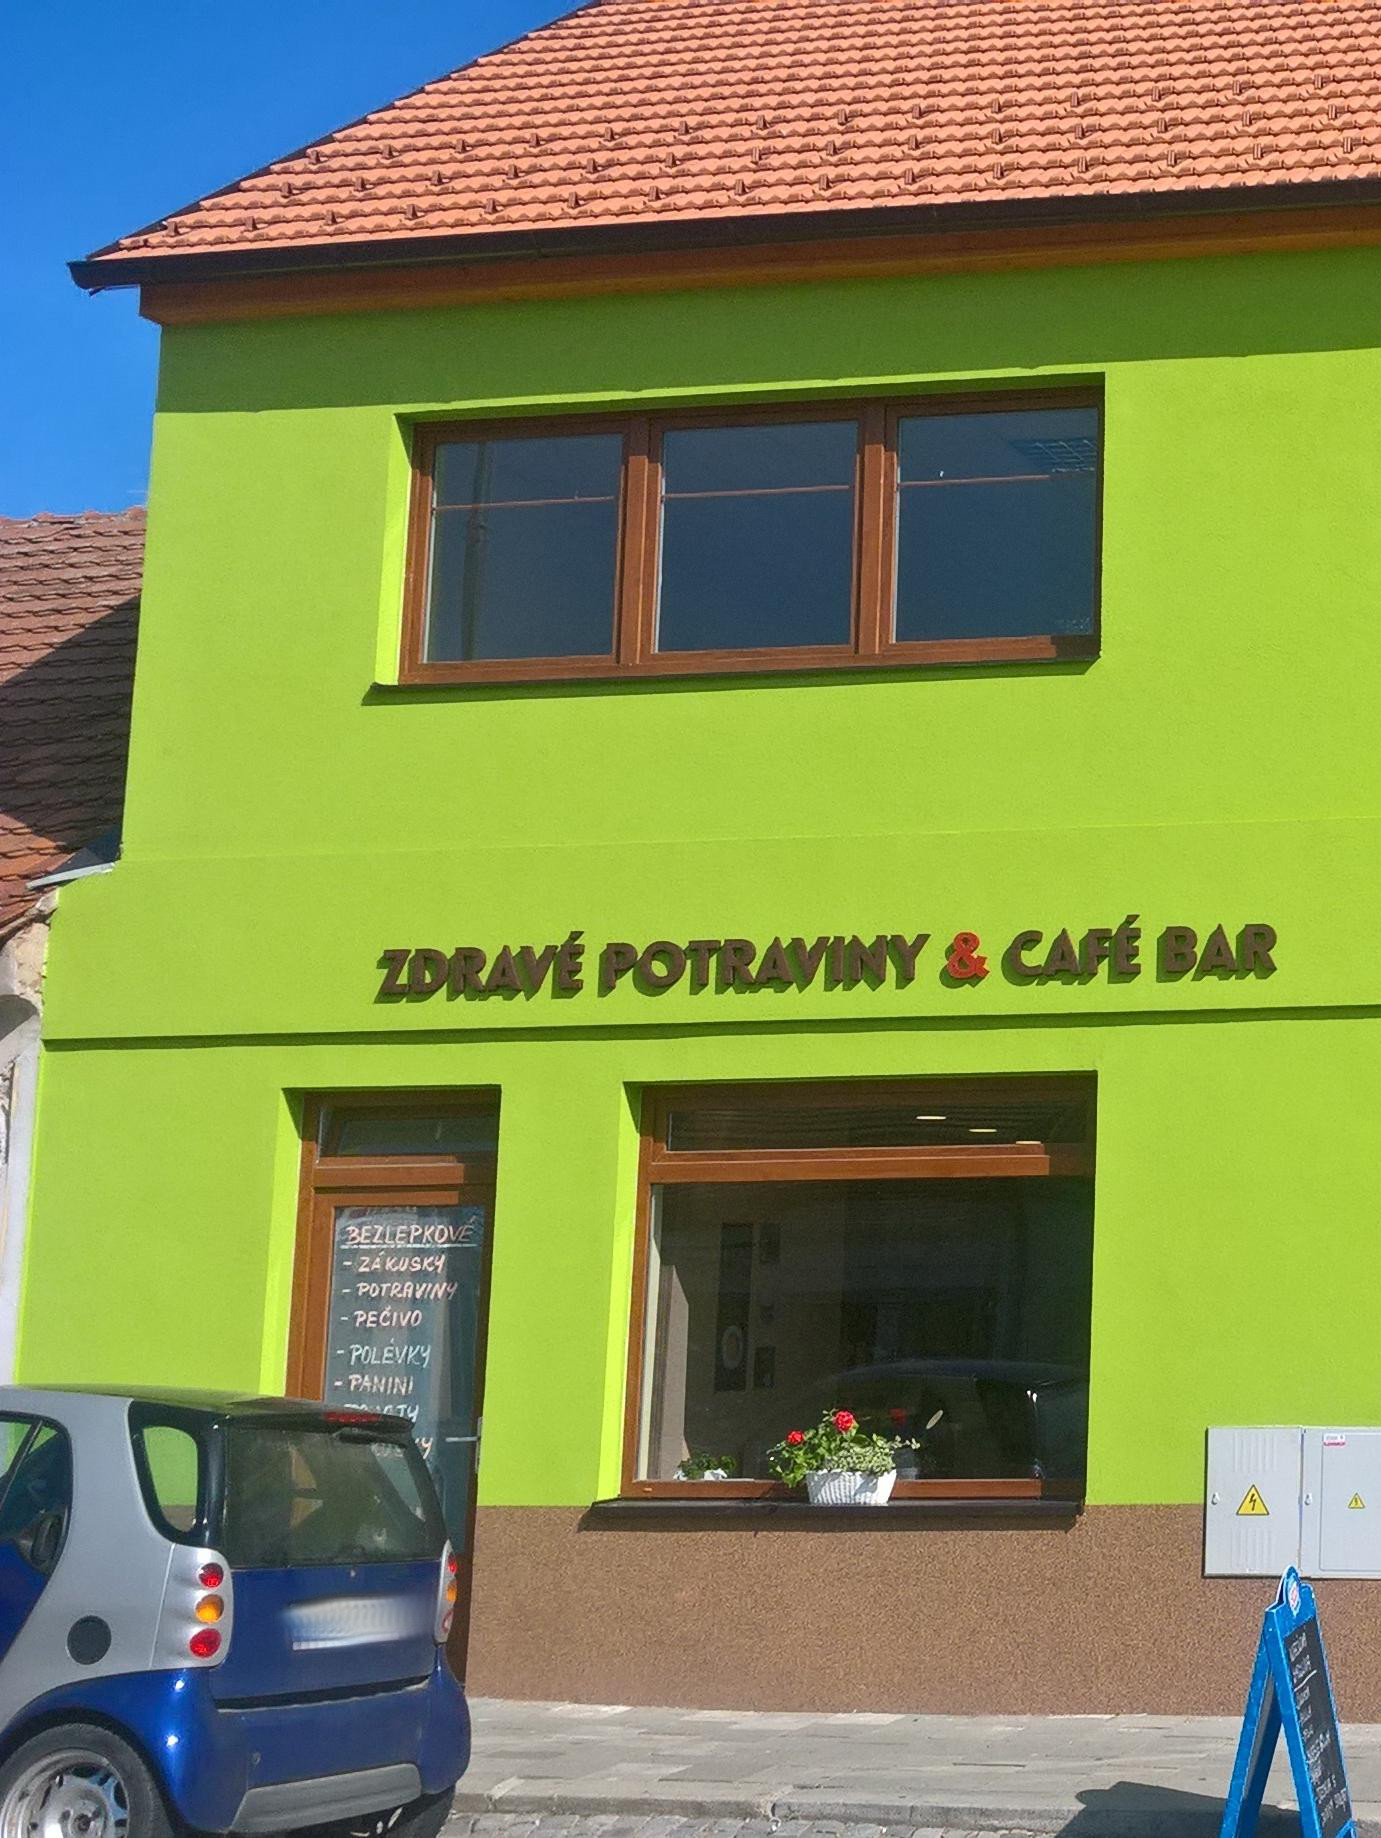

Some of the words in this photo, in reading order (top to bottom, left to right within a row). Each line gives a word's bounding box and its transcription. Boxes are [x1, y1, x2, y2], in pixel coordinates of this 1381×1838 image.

[379, 929, 586, 996] ZDRAVÉ
[602, 932, 932, 990] POTRAVINY
[946, 930, 990, 980] &
[1008, 913, 1142, 978] CAFÉ
[1163, 923, 1278, 974] BAR
[345, 1215, 476, 1245] BEZLEPKOVÉ
[358, 1250, 446, 1273] ZÁKUSKY
[356, 1281, 459, 1300] POTRAVINY
[353, 1305, 423, 1328] PEČIVO
[349, 1337, 432, 1368] POLÉVKY
[348, 1373, 414, 1396] PANINI
